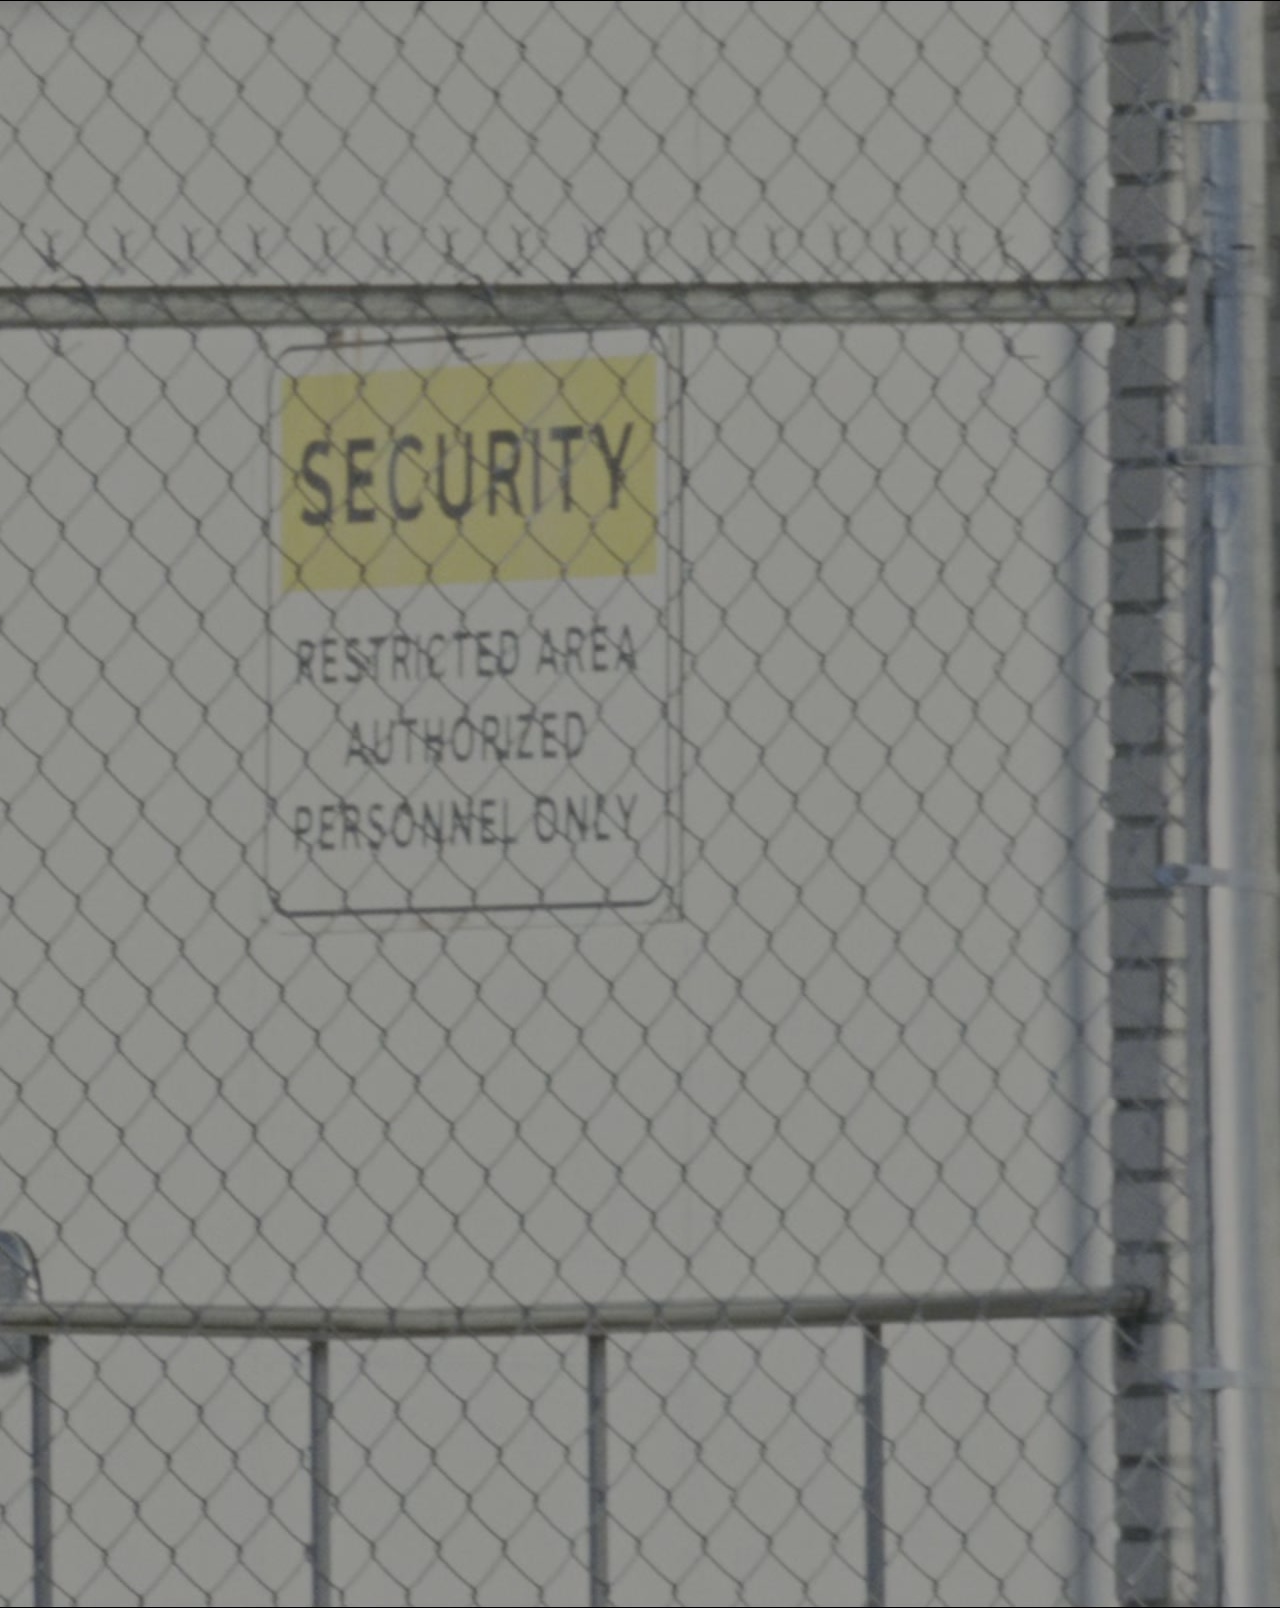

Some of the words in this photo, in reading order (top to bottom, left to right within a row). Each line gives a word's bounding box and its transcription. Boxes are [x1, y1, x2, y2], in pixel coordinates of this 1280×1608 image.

[298, 421, 636, 527] SECURITY
[294, 630, 521, 686] RESTRICTED
[536, 624, 639, 676] AREA
[344, 710, 587, 767] AUTHORIZED
[292, 797, 517, 852] PERSONNEL
[533, 791, 639, 844] ONLY
